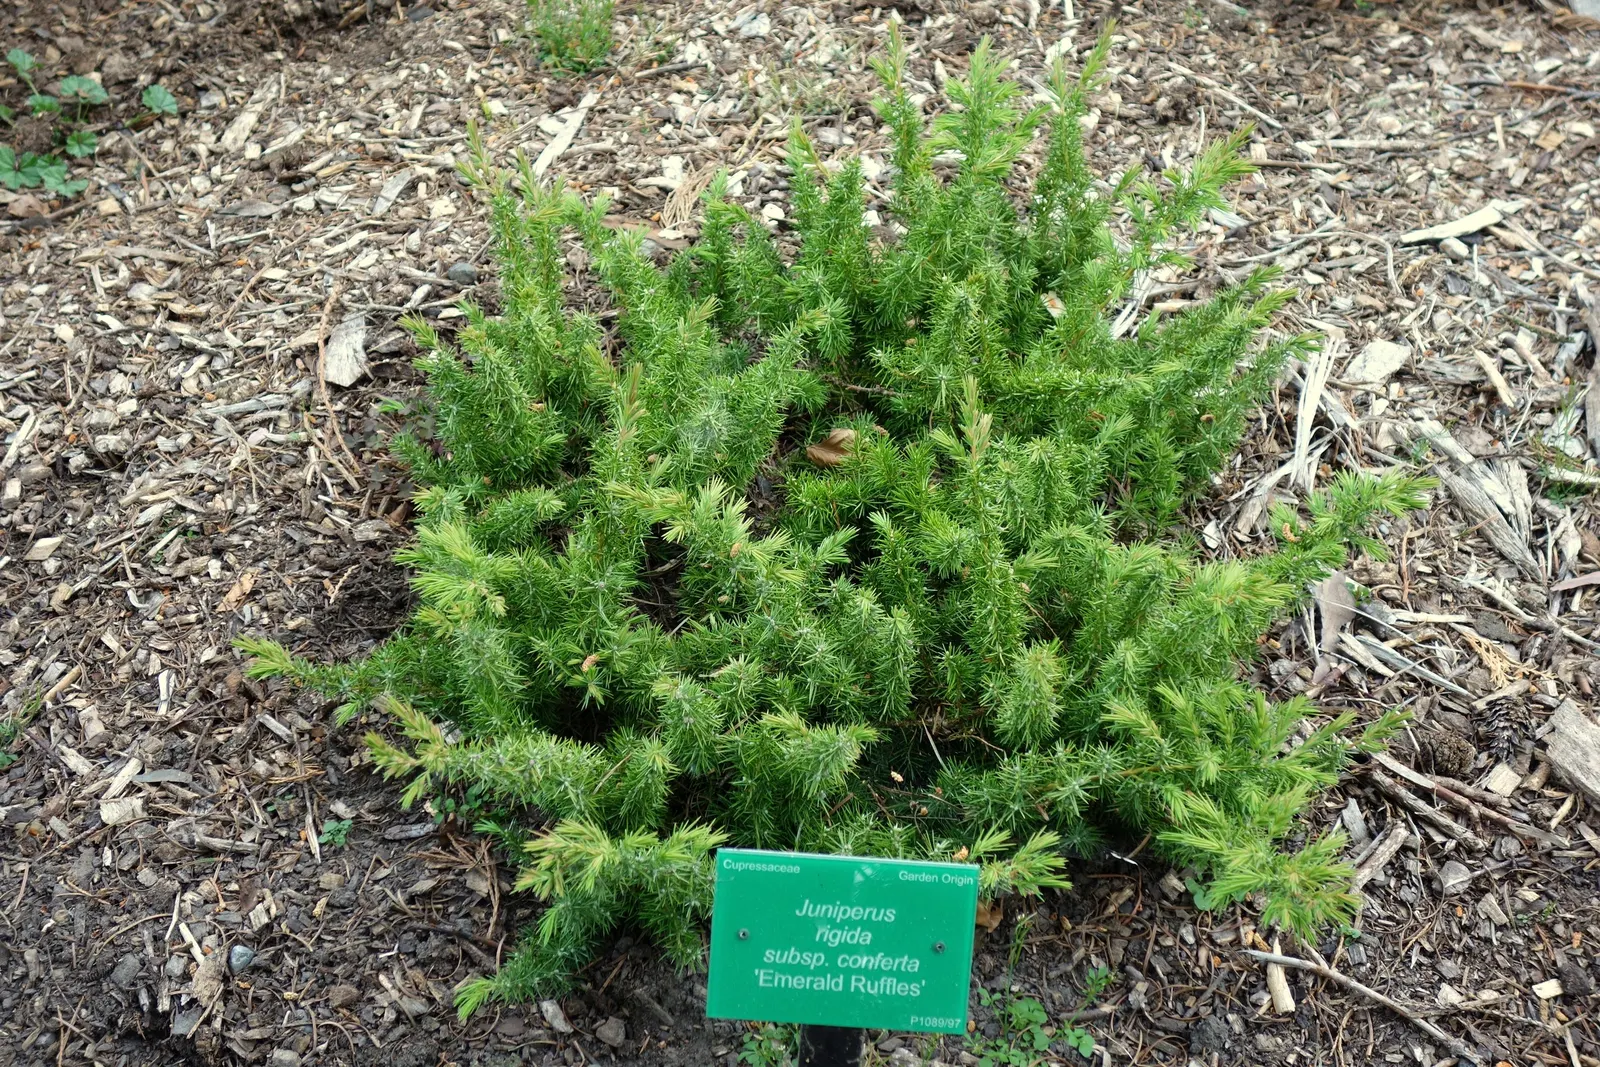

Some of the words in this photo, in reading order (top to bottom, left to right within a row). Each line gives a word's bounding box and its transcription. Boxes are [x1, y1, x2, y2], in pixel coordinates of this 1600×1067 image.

[722, 858, 801, 874] Cupressaceae
[898, 870, 939, 882] Garden
[941, 873, 974, 887] Origin
[795, 899, 896, 923] Juniperus
[815, 925, 872, 948] rigida
[763, 947, 829, 970] subsp.
[837, 952, 920, 973] conferta
[754, 968, 844, 992] 'Emerald
[850, 975, 926, 997] Ruffles'
[910, 1016, 961, 1028] P1089/97
